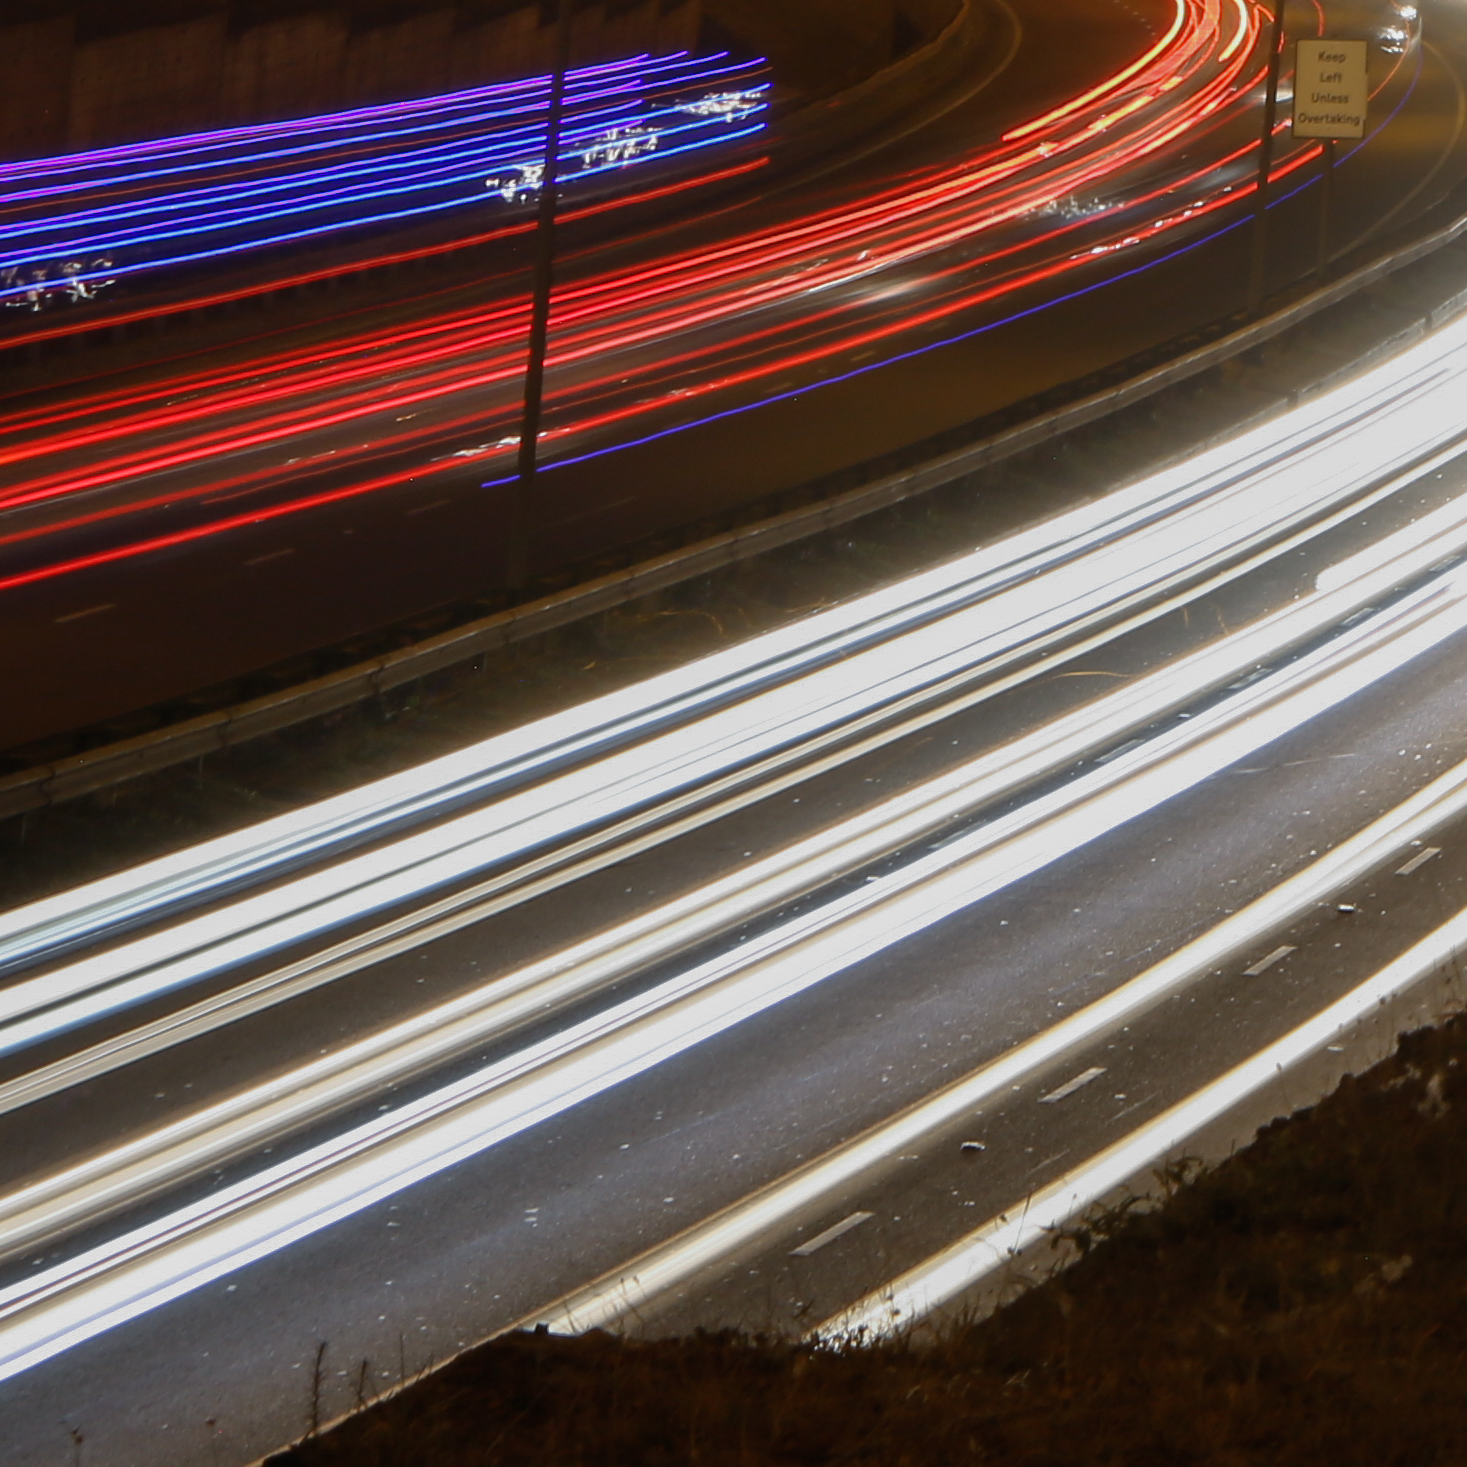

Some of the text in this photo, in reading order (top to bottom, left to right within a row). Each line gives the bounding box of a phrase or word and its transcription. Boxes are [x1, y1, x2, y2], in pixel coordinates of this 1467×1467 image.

[1317, 51, 1346, 64] Keep
[1319, 72, 1342, 83] Left
[1311, 93, 1349, 104] Unless
[1298, 113, 1360, 127] Overtaking
